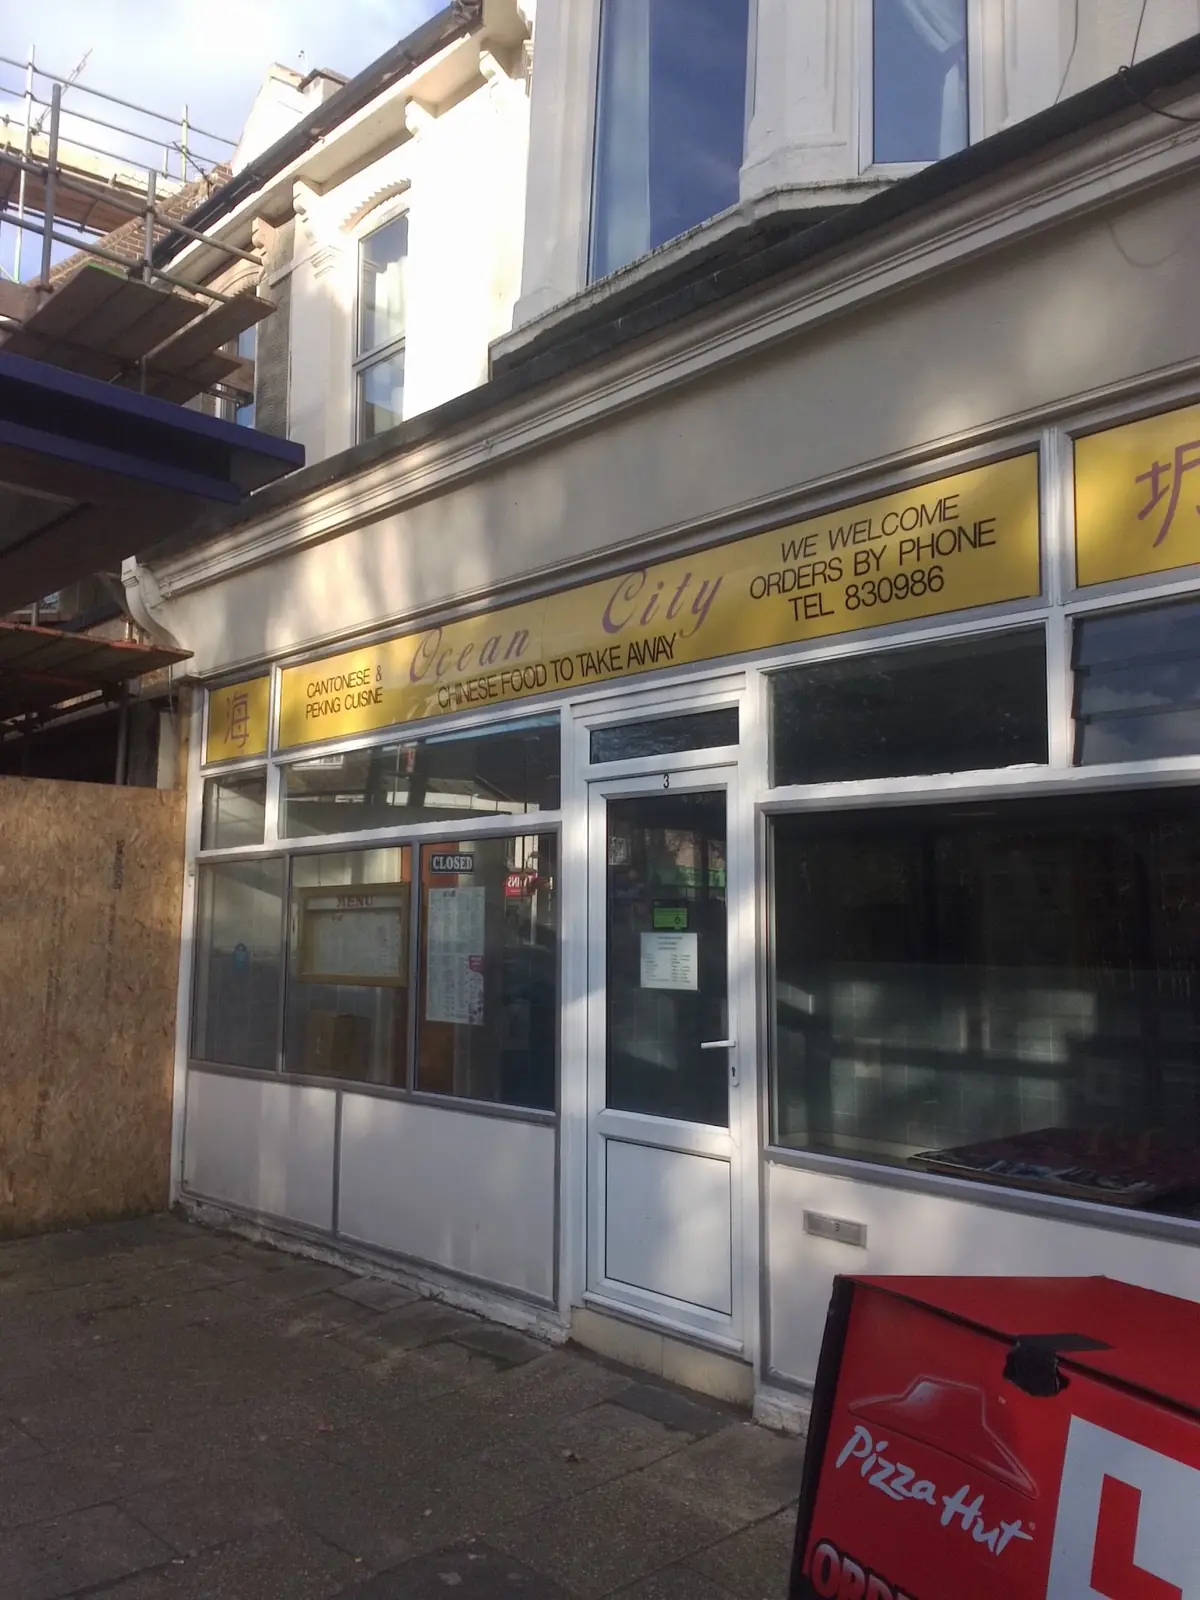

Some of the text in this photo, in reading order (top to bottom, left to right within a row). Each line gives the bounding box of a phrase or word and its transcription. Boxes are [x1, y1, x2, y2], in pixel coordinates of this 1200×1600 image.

[780, 494, 960, 563] WE WELCOME
[750, 517, 996, 600] ORDERS BY PHONE
[788, 565, 944, 622] TEL 830986
[409, 568, 724, 683] Ocean City
[306, 664, 383, 699] CANTONESE &
[437, 632, 676, 708] CHINESE FOOD TO TAKE AWAY
[305, 686, 384, 720] PEKING CUISINE
[662, 772, 670, 789] 3
[432, 855, 473, 870] CLOSED
[336, 895, 375, 908] MENU
[835, 1424, 1034, 1557] Pizza Hut
